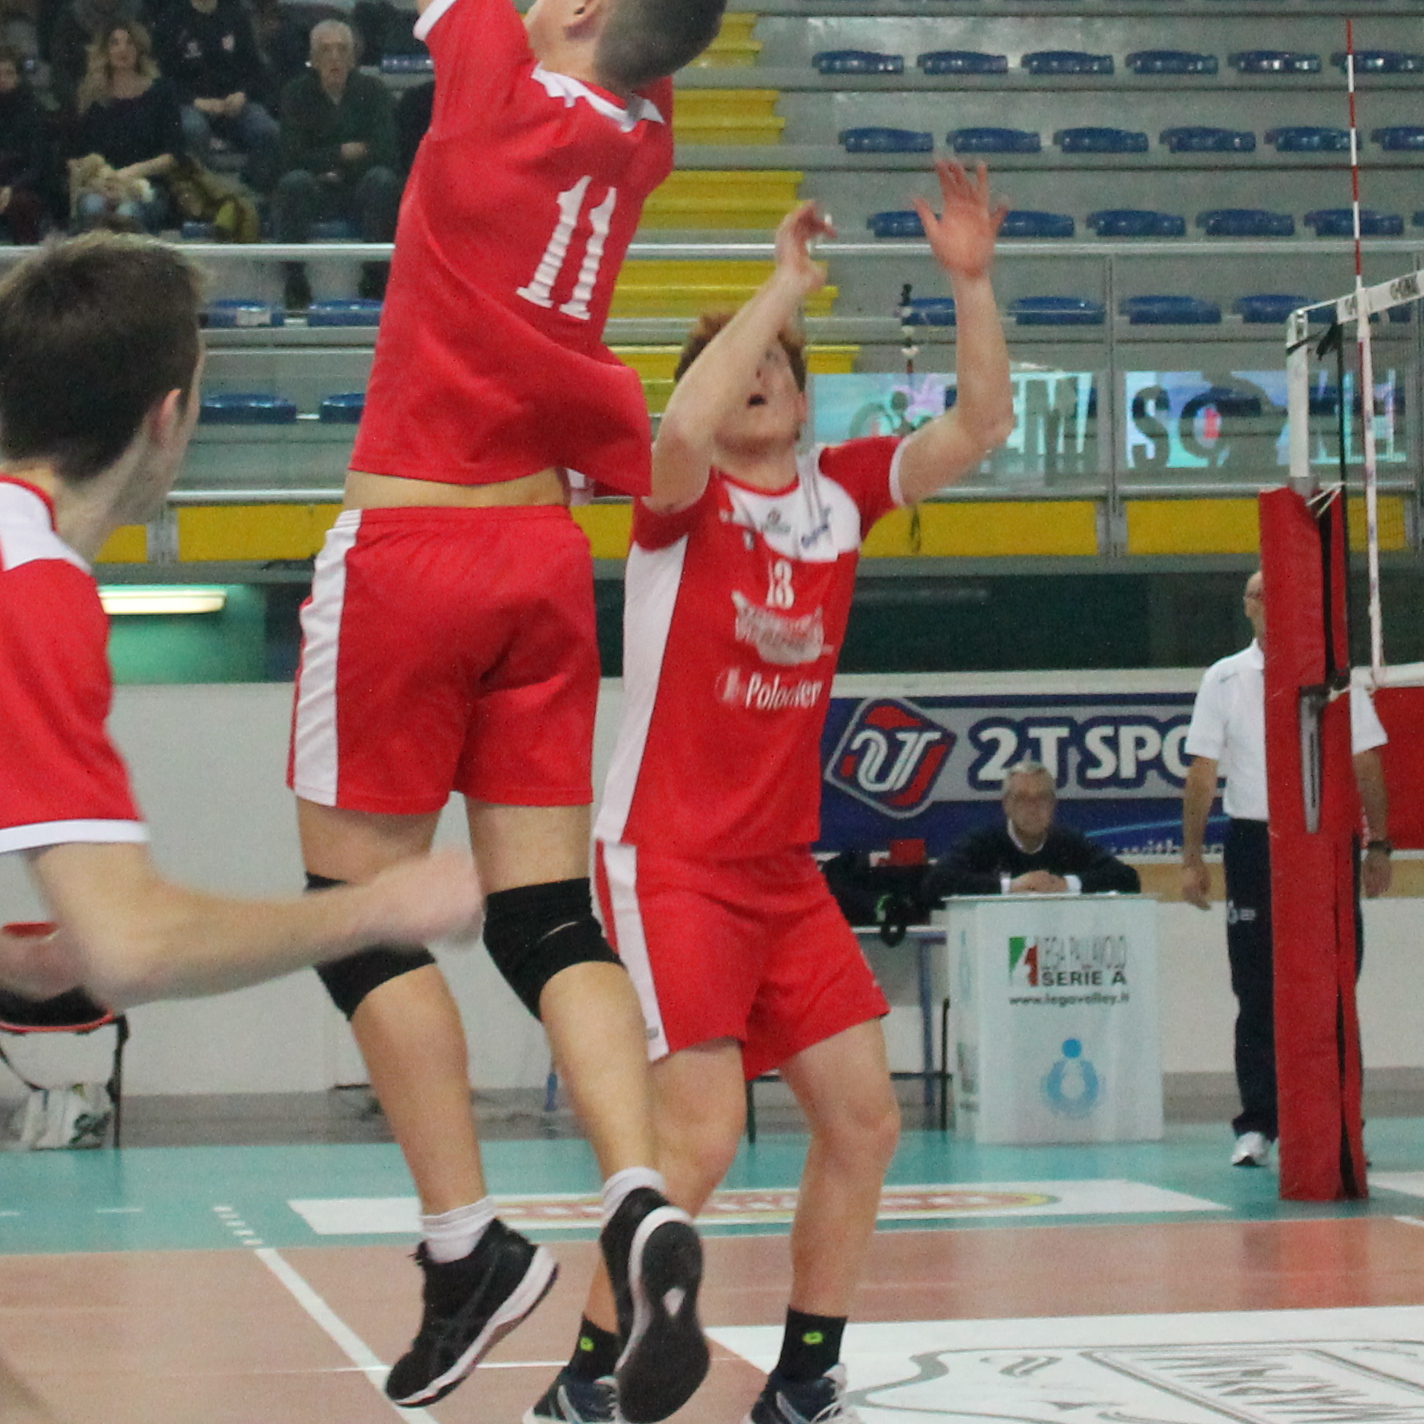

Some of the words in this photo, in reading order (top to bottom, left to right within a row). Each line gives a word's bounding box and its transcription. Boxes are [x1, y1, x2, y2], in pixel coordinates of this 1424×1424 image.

[517, 175, 618, 321] 11
[1041, 970, 1103, 987] SERIE
[1111, 969, 1127, 985] A
